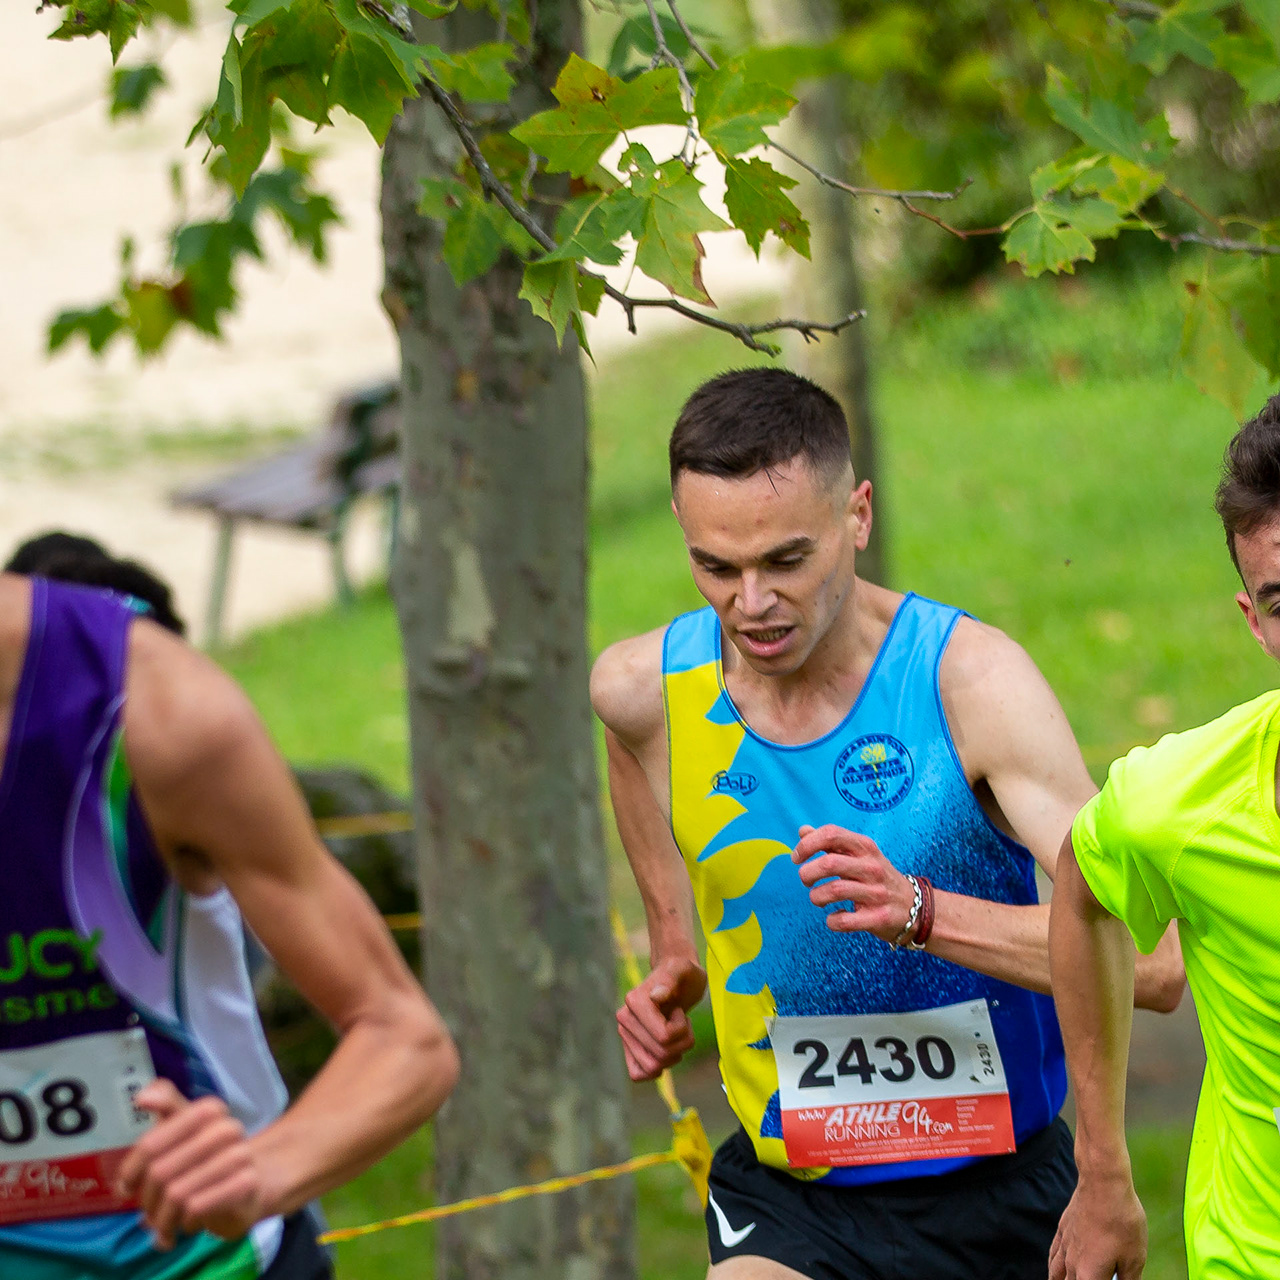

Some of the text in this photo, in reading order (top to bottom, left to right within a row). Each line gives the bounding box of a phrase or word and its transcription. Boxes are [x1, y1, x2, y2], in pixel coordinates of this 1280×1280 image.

[792, 1034, 957, 1090] 2430
[976, 1042, 996, 1077] 2430
[824, 1121, 901, 1143] RUNNING
